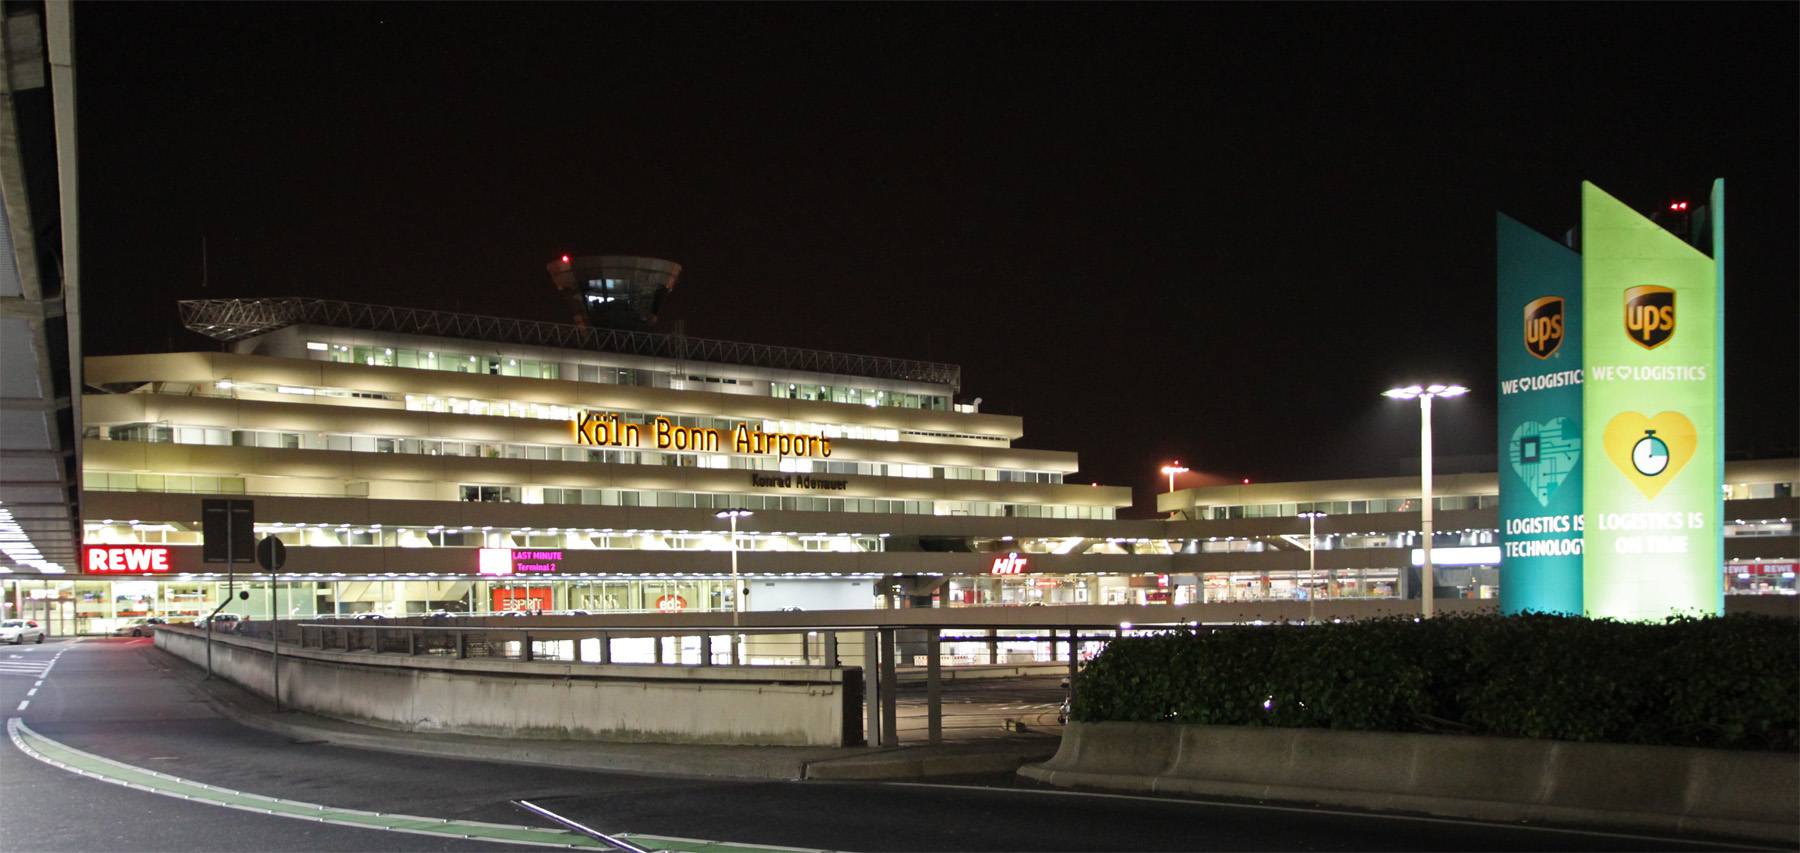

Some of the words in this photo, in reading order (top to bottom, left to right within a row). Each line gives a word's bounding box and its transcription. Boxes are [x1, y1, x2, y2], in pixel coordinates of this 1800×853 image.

[1628, 305, 1673, 340] ups
[1528, 314, 1561, 351] ups
[1592, 366, 1614, 381] WE
[1634, 366, 1706, 381] LOGISTICS
[1502, 380, 1518, 395] WE
[577, 411, 639, 448] Köln
[655, 416, 718, 452] Bonn
[736, 422, 831, 463] Airport
[752, 473, 791, 488] Konrad
[796, 475, 848, 490] Adenauer
[1506, 515, 1570, 535] LOGISTICS
[1599, 512, 1684, 531] LOGISTICS
[1688, 512, 1704, 529] IS
[1615, 536, 1642, 554] ON
[1647, 536, 1689, 553] TIME
[89, 548, 169, 571] REWE
[512, 552, 532, 560] LAST
[533, 552, 562, 560] MINUTE
[517, 563, 549, 571] Terminal
[550, 563, 556, 571] 2
[1764, 564, 1793, 573] REWE
[503, 598, 543, 611] ESPRIT
[659, 597, 682, 611] edc
